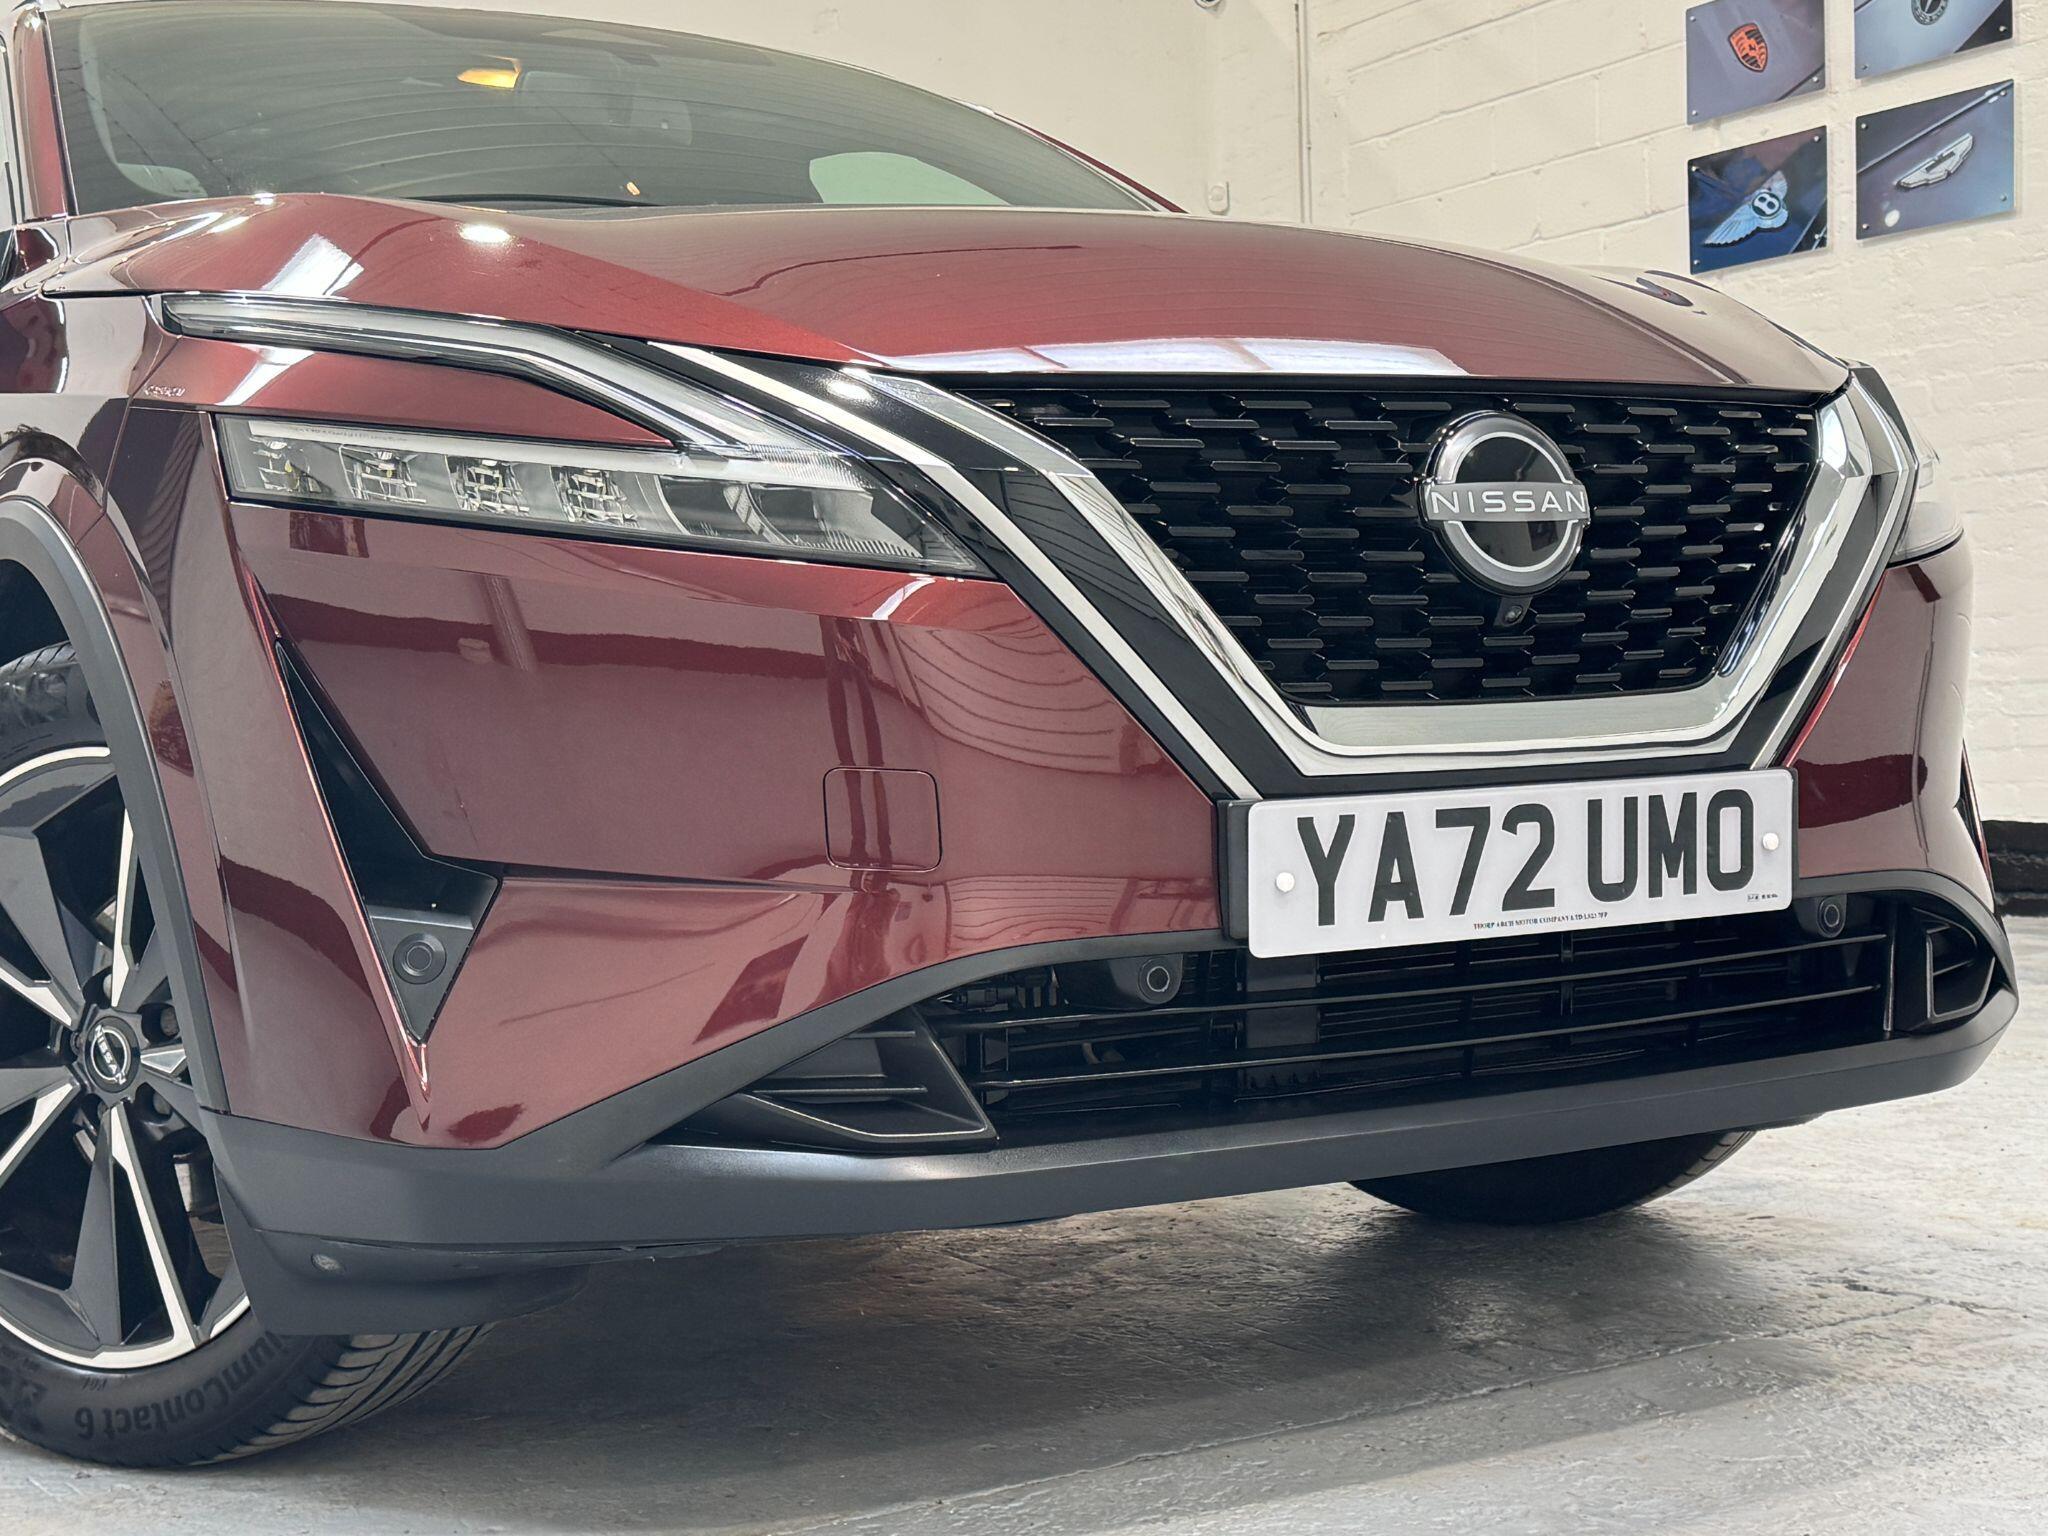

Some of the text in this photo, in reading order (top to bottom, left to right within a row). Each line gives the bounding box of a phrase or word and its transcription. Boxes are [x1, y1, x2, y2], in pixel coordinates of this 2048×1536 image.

[1430, 490, 1588, 514] NISSAN
[1296, 788, 1755, 927] YA72 UMO
[1515, 917, 1538, 926] MOTOR
[1539, 914, 1569, 924] COMPANY
[95, 1024, 126, 1085] NISSAN
[74, 1406, 95, 1439] 6
